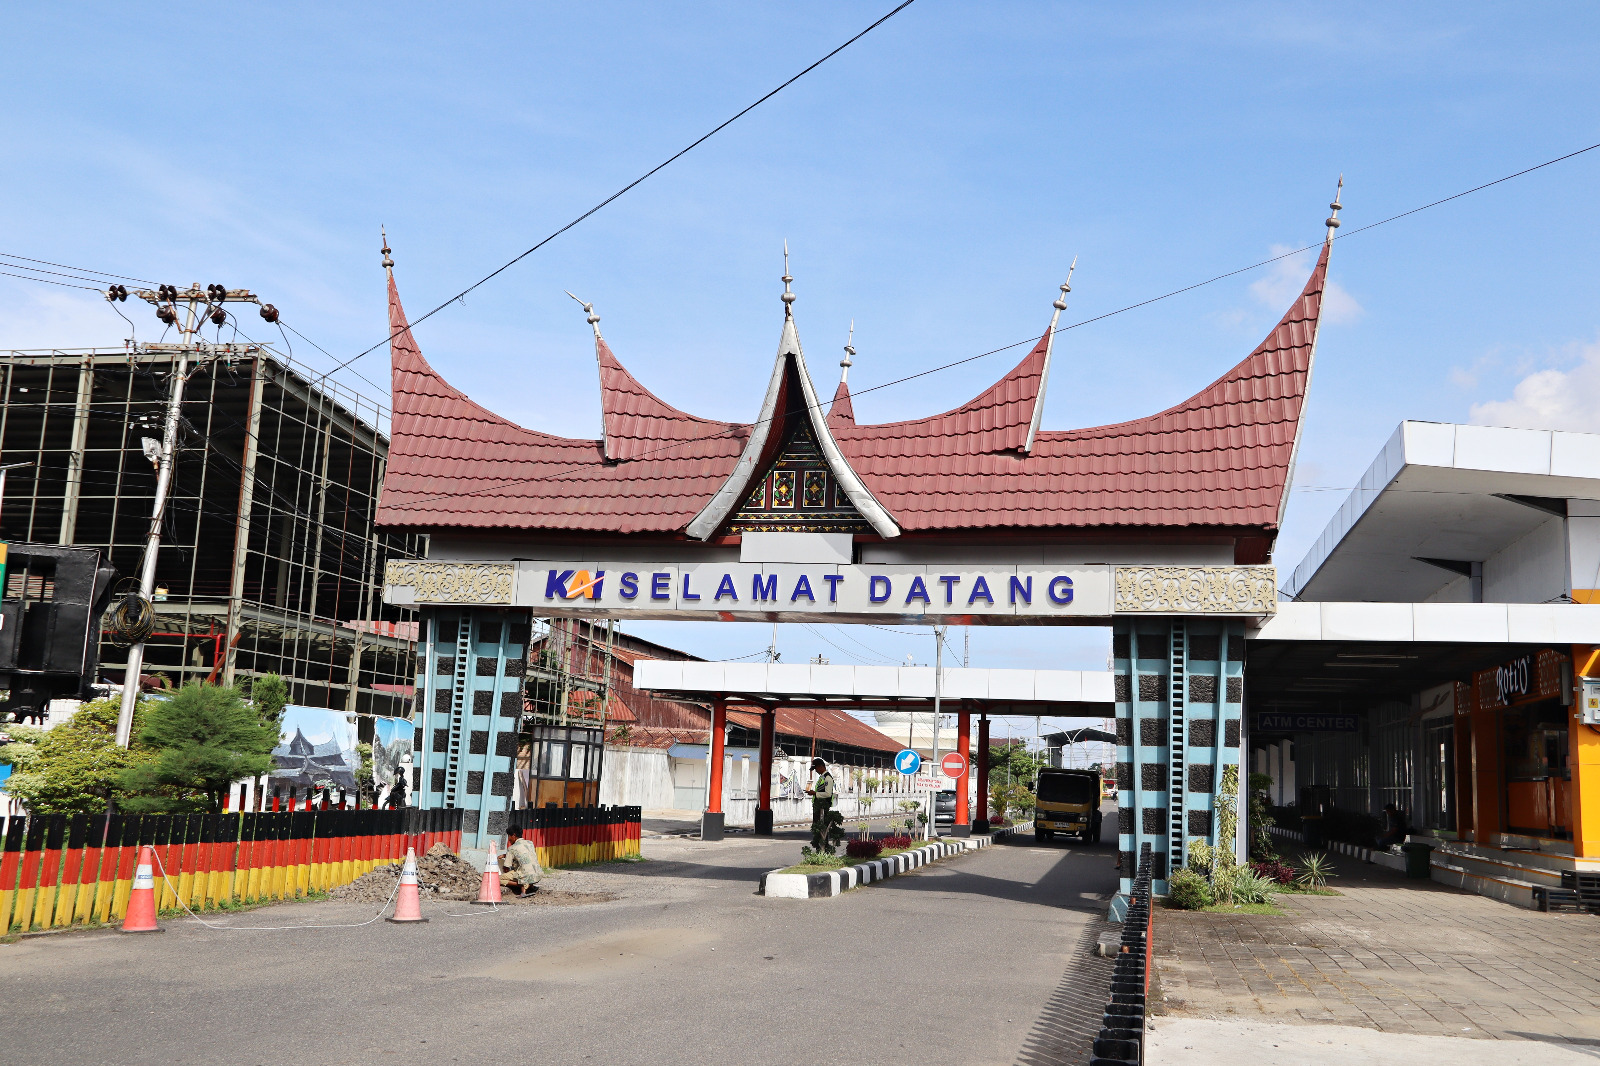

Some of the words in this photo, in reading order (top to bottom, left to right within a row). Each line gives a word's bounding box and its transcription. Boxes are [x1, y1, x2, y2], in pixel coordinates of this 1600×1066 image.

[545, 570, 605, 599] KAI
[619, 572, 844, 602] SELAMAT
[869, 575, 1074, 604] DATANG
[1262, 716, 1292, 728] ATM
[1296, 717, 1355, 729] CENTER
